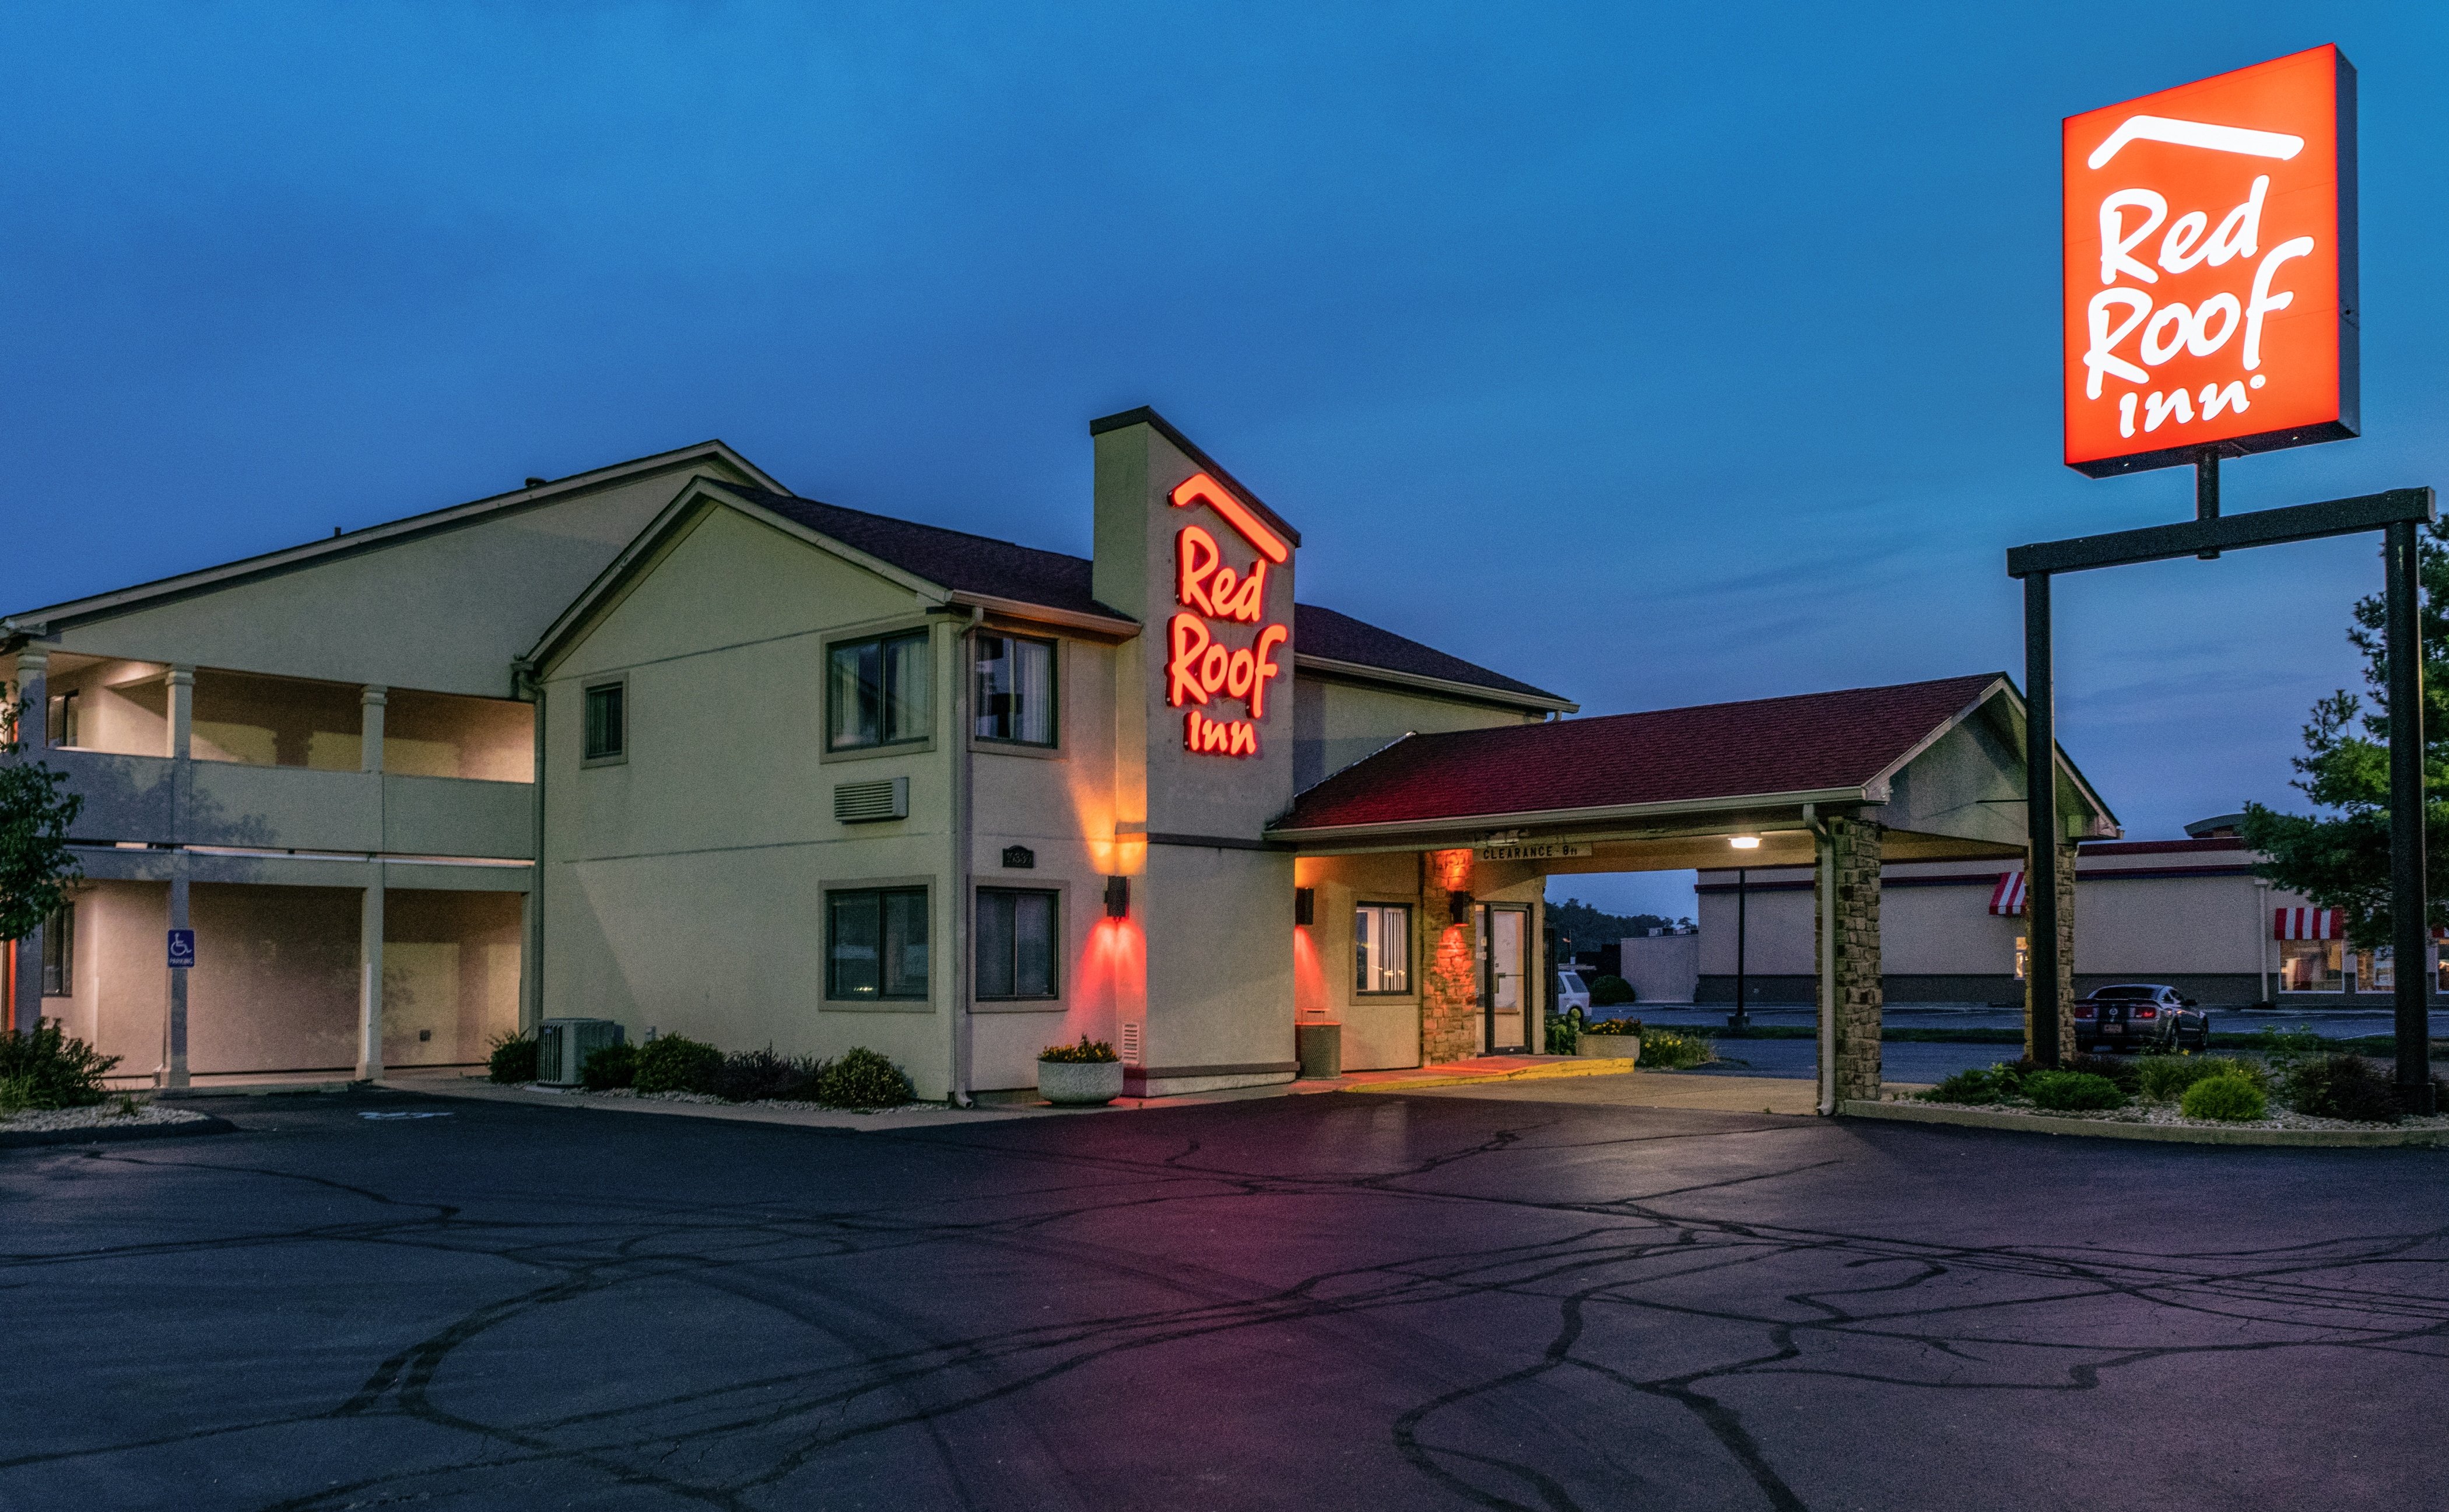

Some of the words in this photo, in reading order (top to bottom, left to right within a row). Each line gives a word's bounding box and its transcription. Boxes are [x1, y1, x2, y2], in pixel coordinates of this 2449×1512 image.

[2099, 174, 2270, 285] Red
[2083, 236, 2315, 401] Roof
[1177, 525, 1267, 623] Red
[1167, 612, 1288, 718] Roof
[1483, 845, 1553, 860] CLEARANCE
